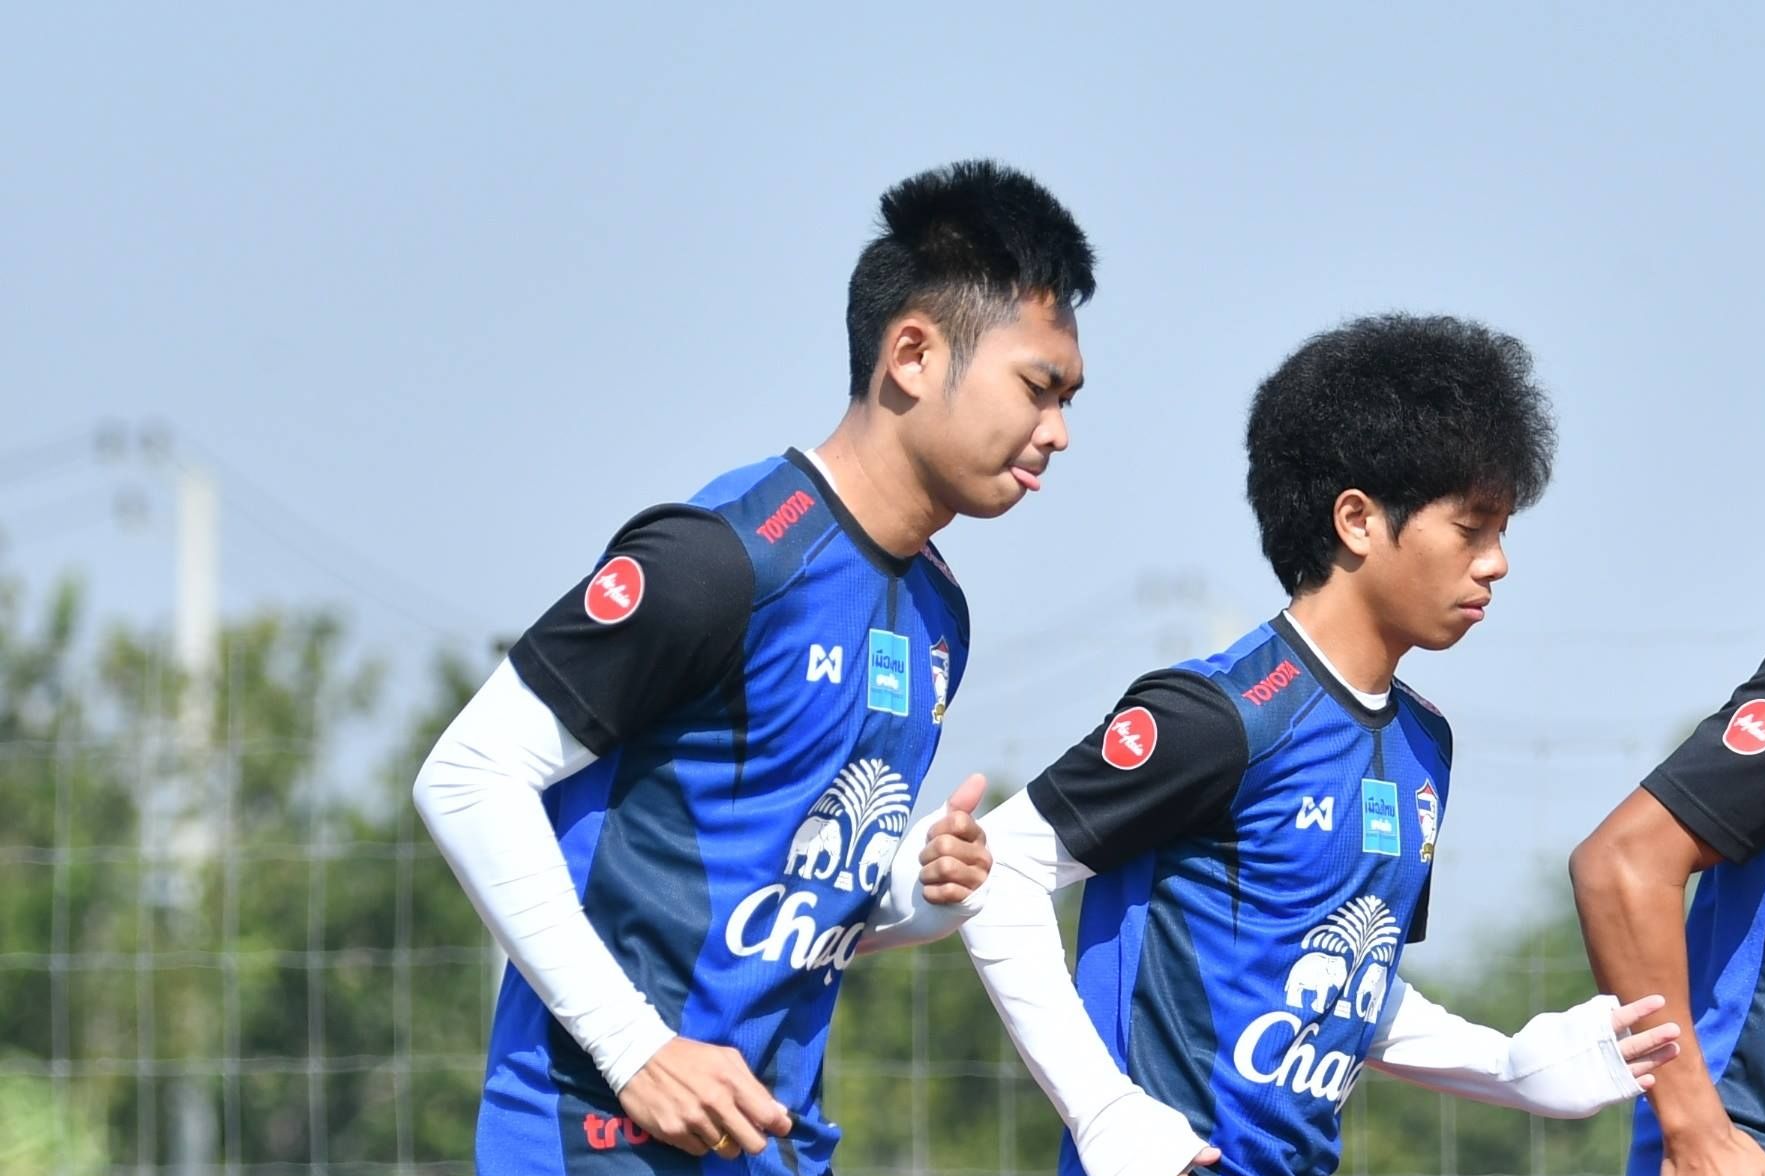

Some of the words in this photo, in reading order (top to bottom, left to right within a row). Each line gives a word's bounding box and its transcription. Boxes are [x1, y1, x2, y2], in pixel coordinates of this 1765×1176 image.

[756, 490, 815, 544] TOYOTA
[1241, 660, 1300, 706] TOYOTA
[1233, 1010, 1364, 1115] Cha
[583, 1113, 651, 1150] tru
